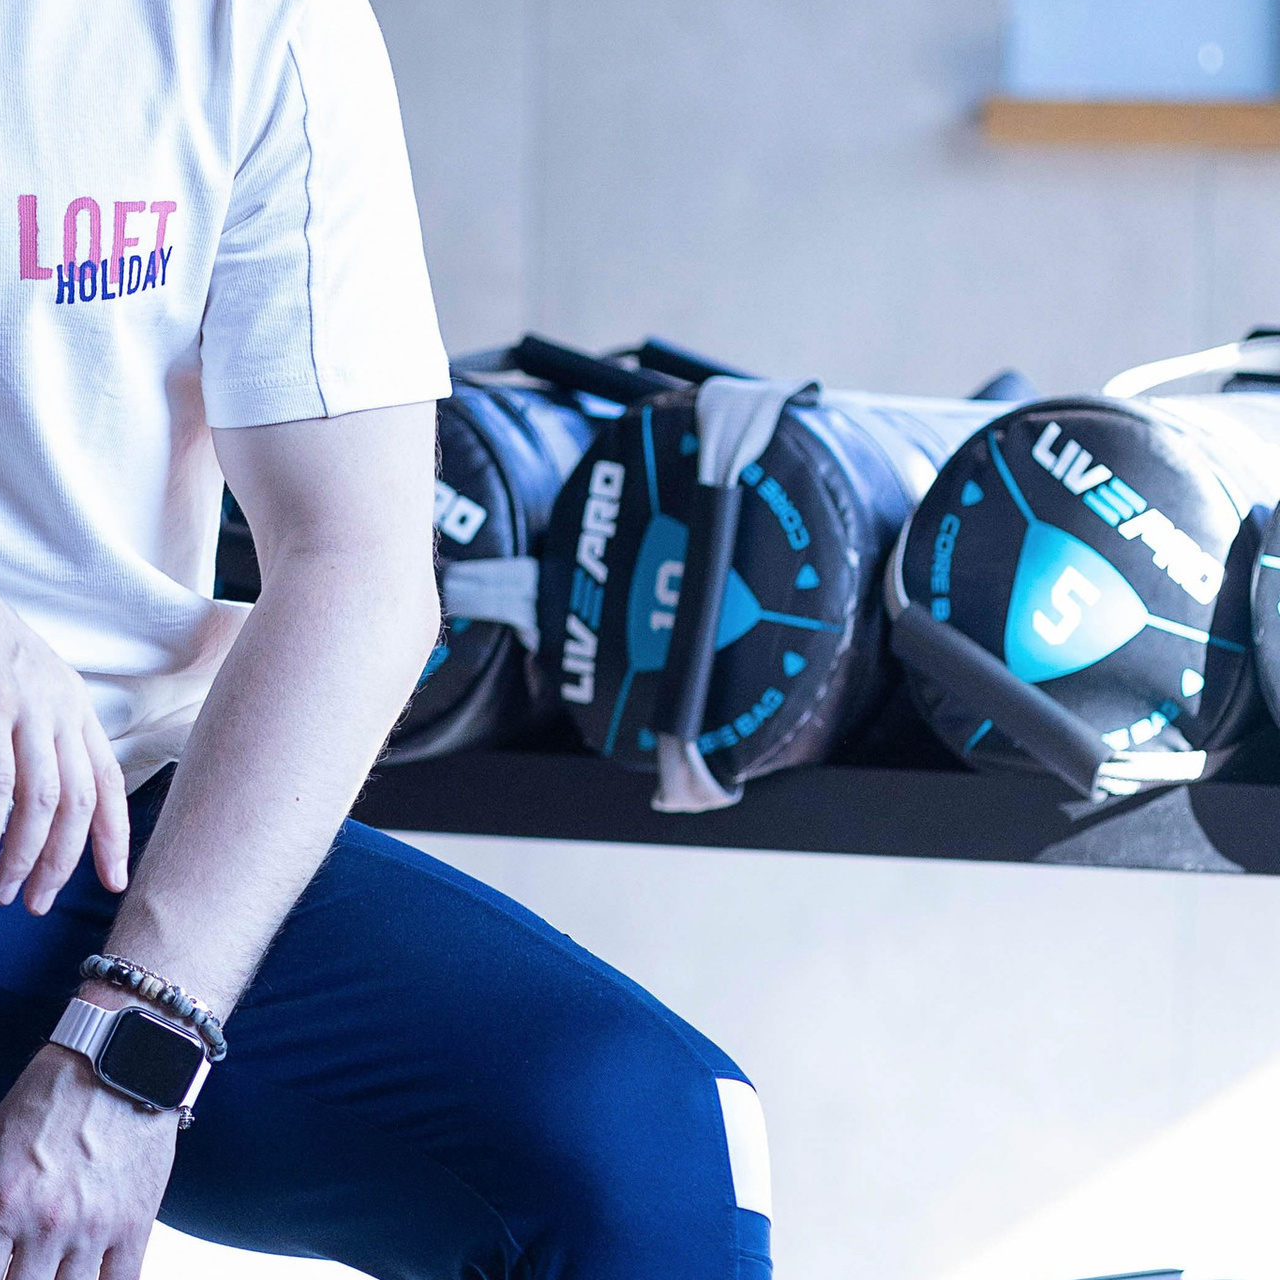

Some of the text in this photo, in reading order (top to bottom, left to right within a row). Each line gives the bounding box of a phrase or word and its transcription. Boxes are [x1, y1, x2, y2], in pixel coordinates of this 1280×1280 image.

[18, 194, 177, 284] LOFT
[56, 246, 173, 304] HOLIDAY
[756, 476, 810, 551] CORE
[930, 513, 961, 595] CORE
[1031, 421, 1226, 606] LIVEPRO
[560, 459, 625, 705] LIVEPRO
[1032, 565, 1102, 646] 5
